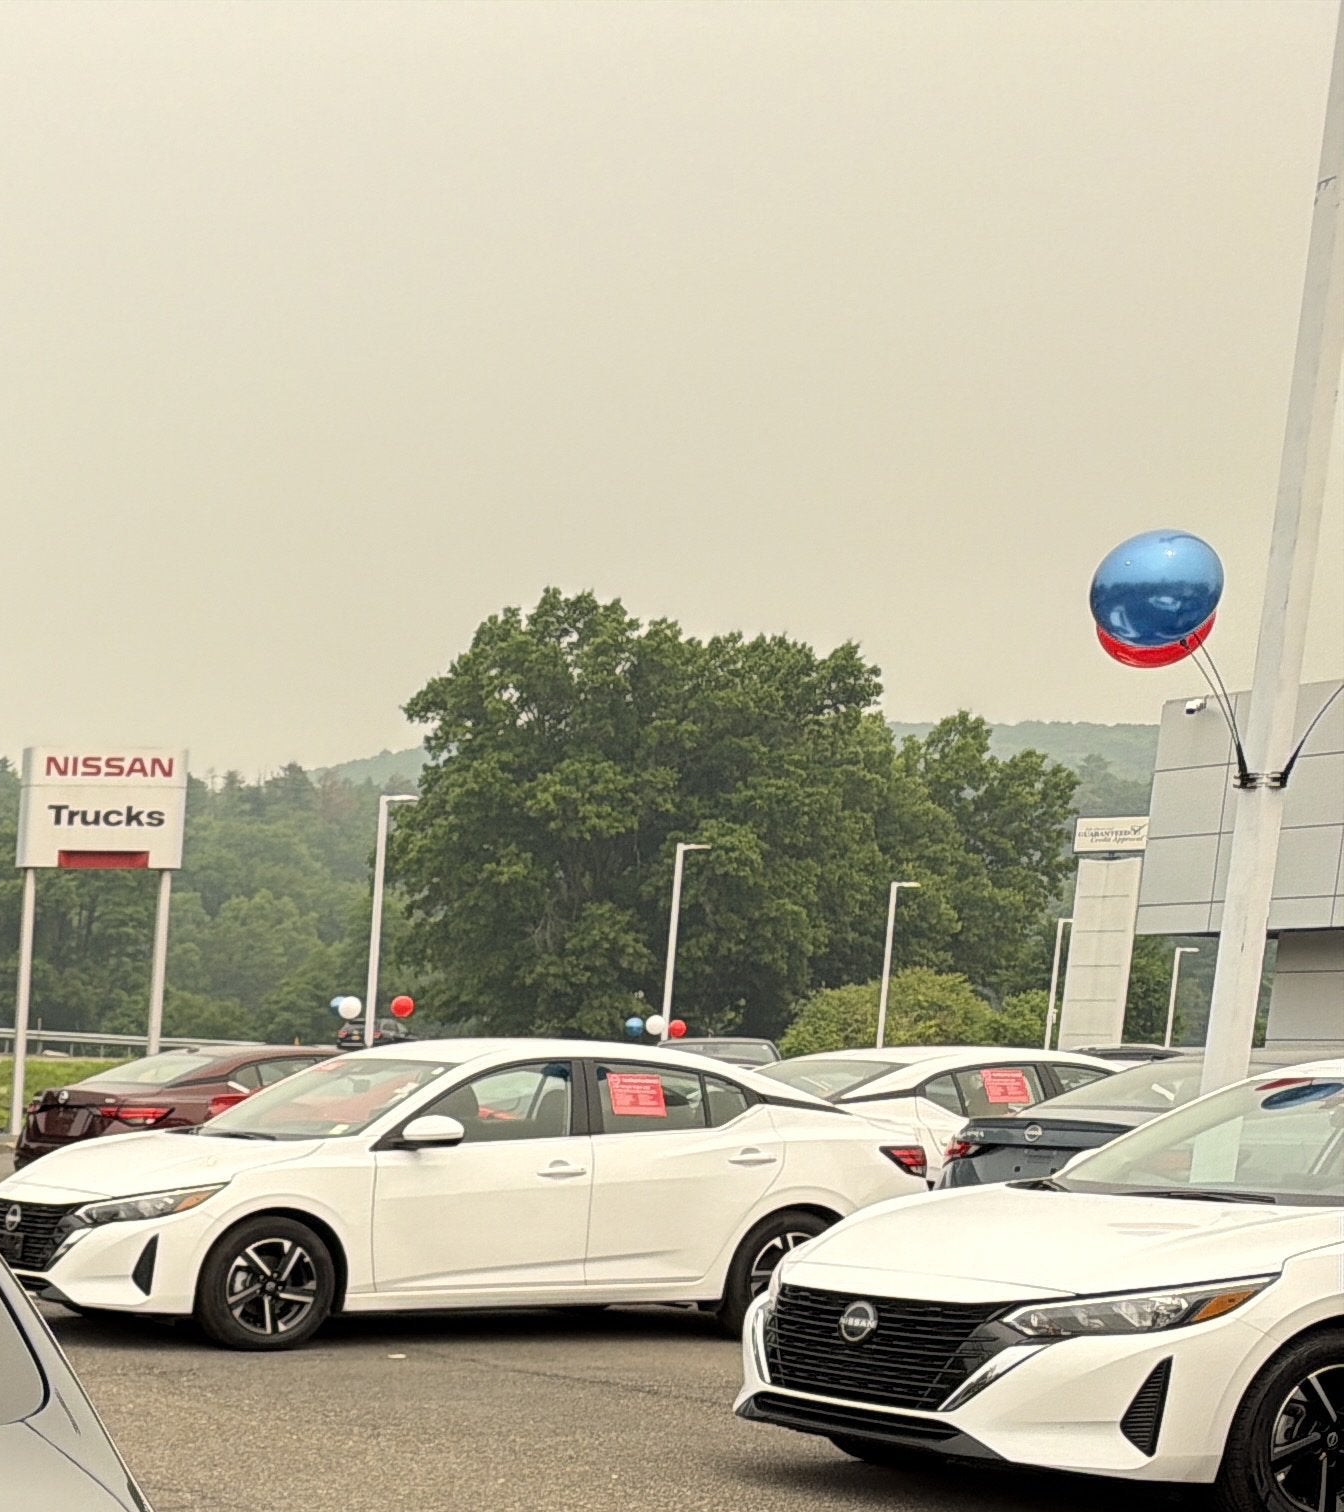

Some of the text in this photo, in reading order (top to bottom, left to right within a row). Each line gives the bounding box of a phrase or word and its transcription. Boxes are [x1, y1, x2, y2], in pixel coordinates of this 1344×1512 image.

[45, 756, 174, 778] NISSAN
[47, 804, 166, 827] Trucks
[838, 1316, 879, 1329] NISSAN
